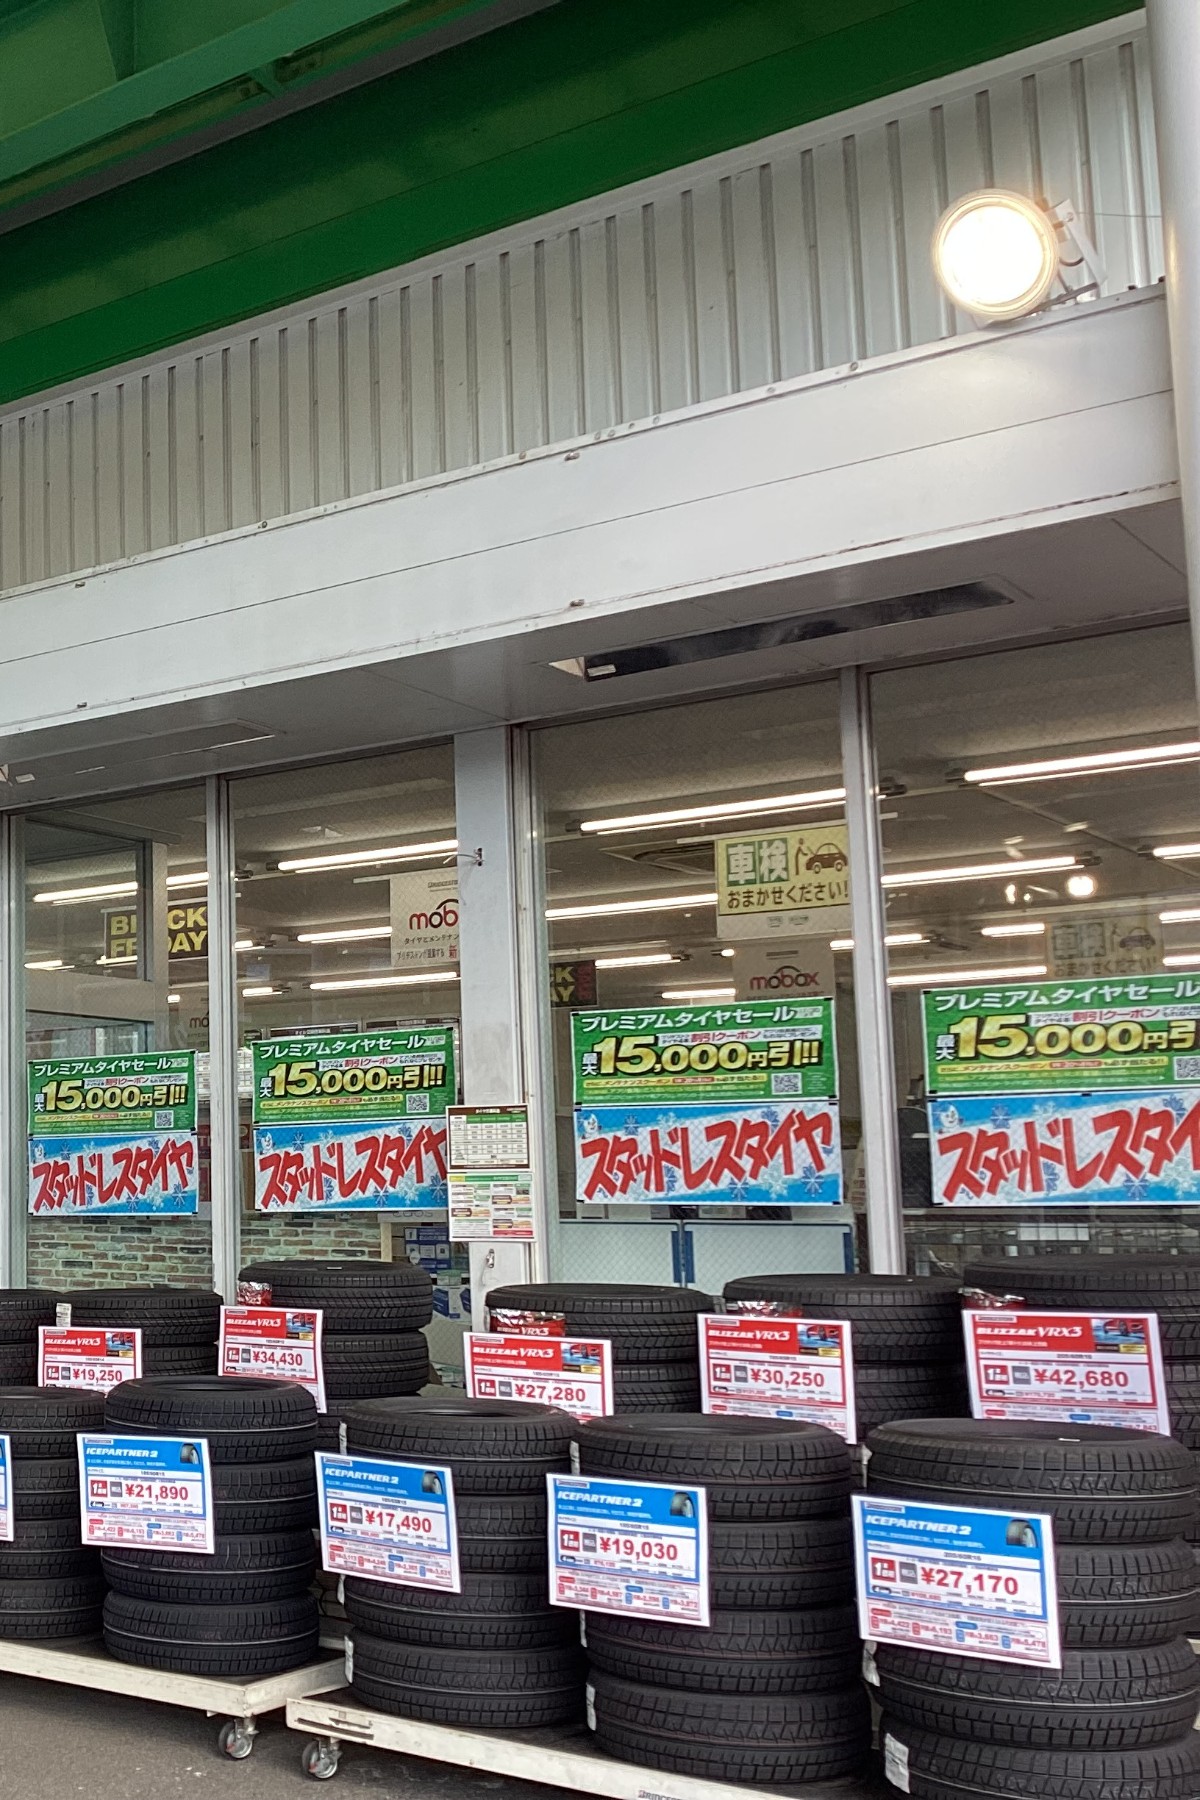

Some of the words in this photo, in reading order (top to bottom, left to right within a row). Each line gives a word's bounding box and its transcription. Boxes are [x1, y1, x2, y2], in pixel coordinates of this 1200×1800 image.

[727, 839, 789, 885] 車検
[727, 880, 849, 909] おまかせください!
[409, 904, 459, 930] mob
[750, 969, 820, 991] mobox
[935, 980, 1200, 1011] プレミアムタイヤセール
[581, 1005, 796, 1032] プレミアムタイヤセール
[260, 1035, 426, 1059] プレミアムタイヤセール
[34, 1057, 173, 1077] プレミアムタイヤセール
[581, 1109, 834, 1200] スタッドレスタイヤ
[937, 1098, 1200, 1202] スタッドレスタイ
[32, 1137, 194, 1212] スタッドレスタイヤ
[259, 1125, 448, 1209] スタッドレスタイヤ
[755, 1330, 790, 1341] VRX3
[976, 1326, 1037, 1336] BLIZZAK
[1037, 1326, 1083, 1338] VRX3
[252, 1351, 303, 1367] ¥34,430
[519, 1347, 554, 1358] VRX3
[72, 1368, 123, 1384] ¥19,250
[750, 1368, 825, 1388] ¥30,250
[1033, 1368, 1130, 1389] ¥42,680
[515, 1383, 586, 1405] ¥27,280
[125, 1483, 189, 1501] ¥21,890
[365, 1509, 432, 1533] ¥17,490
[600, 1536, 678, 1561] ¥19,030
[921, 1566, 1019, 1596] ¥27,170
